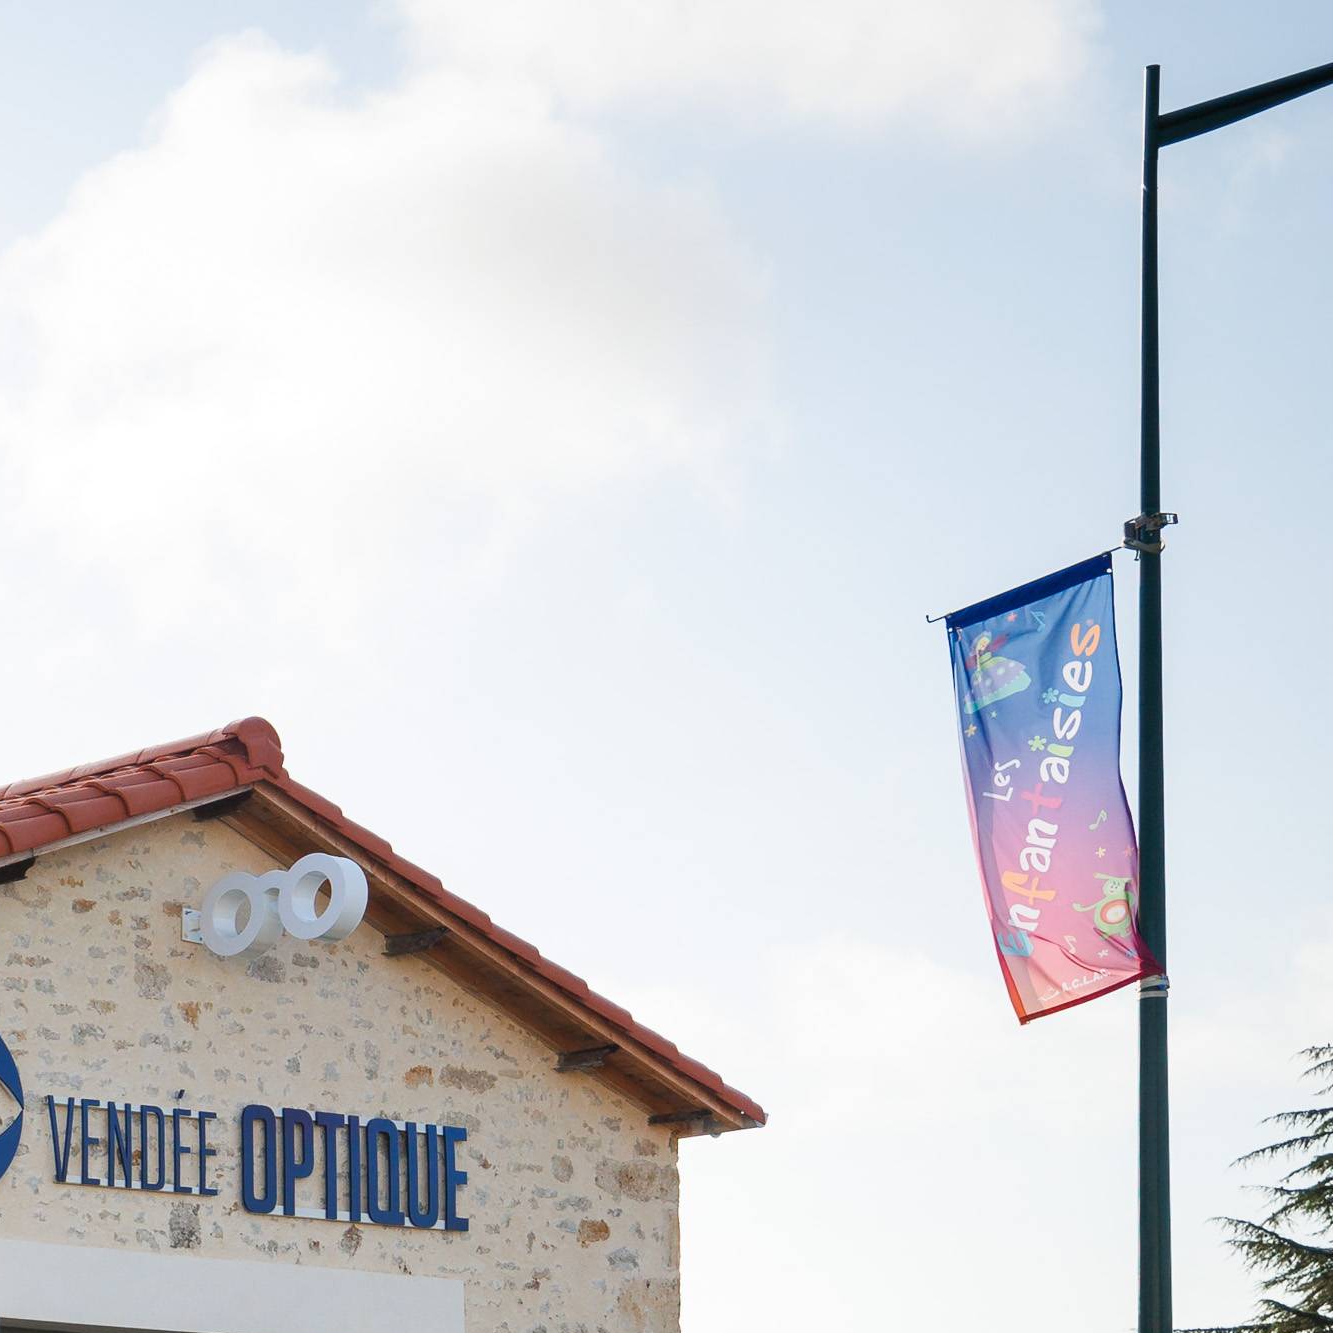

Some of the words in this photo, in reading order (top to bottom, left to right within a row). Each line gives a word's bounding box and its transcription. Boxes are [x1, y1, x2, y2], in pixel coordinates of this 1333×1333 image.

[983, 757, 1020, 801] Les
[998, 624, 1100, 958] Enfantaisies
[47, 1090, 217, 1195] VENDÉE
[241, 1104, 469, 1232] OPTIQUE
